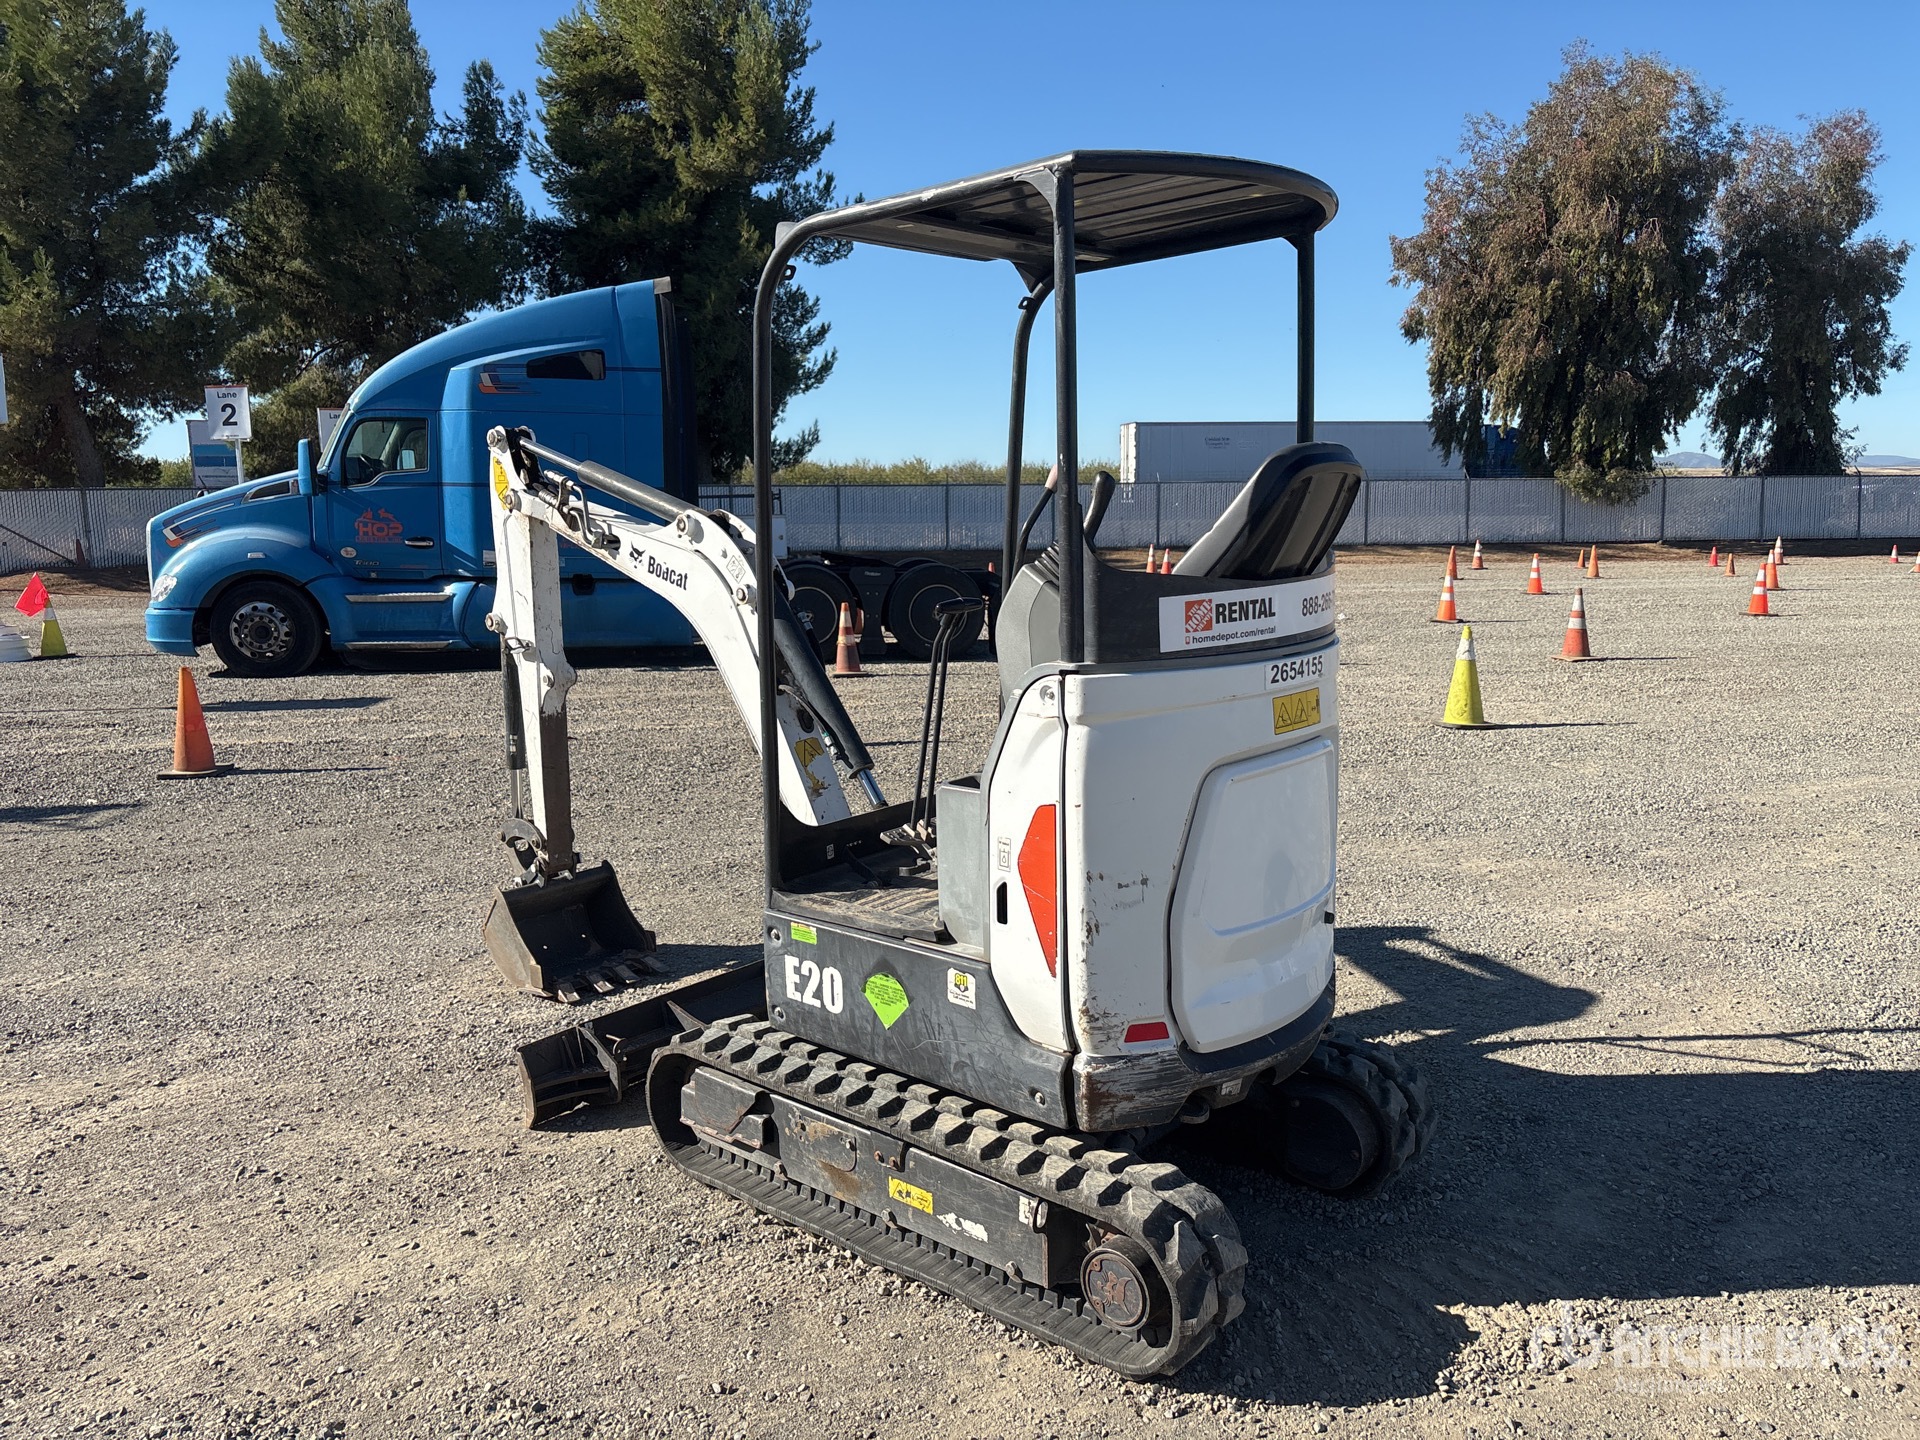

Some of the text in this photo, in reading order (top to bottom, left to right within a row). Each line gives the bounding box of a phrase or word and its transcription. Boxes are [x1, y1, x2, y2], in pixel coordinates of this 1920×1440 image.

[216, 390, 238, 399] Lane
[220, 403, 238, 427] 2
[358, 522, 404, 537] HOP
[1215, 597, 1276, 624] RENTAL
[1192, 626, 1276, 644] homedepot.com/rental
[1270, 655, 1323, 684] 2654155
[784, 953, 844, 1015] E20
[955, 973, 968, 987] 811
